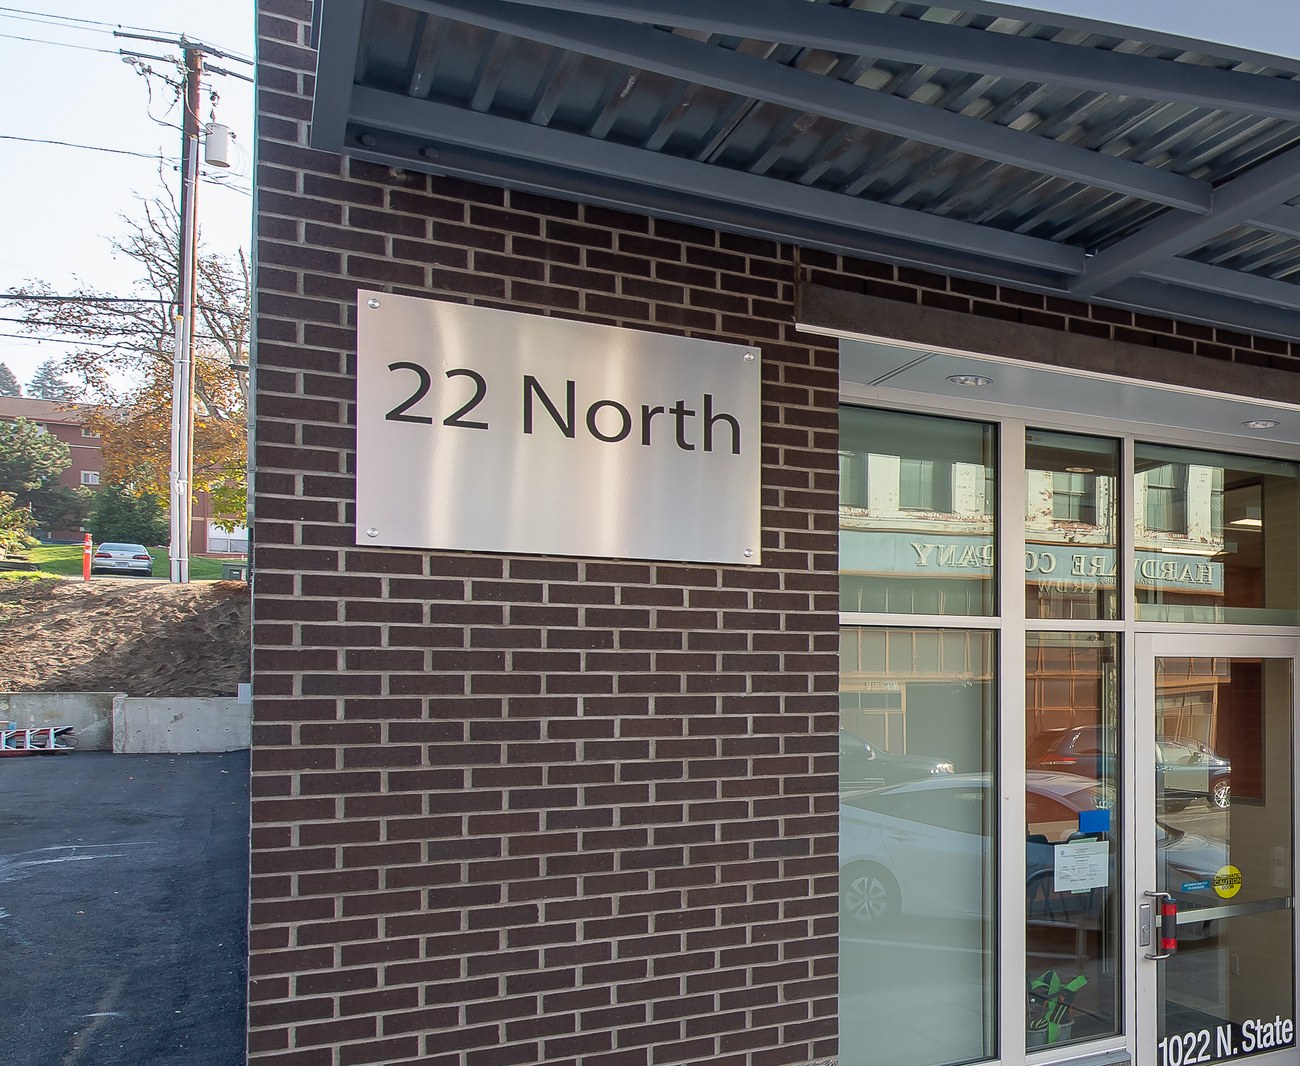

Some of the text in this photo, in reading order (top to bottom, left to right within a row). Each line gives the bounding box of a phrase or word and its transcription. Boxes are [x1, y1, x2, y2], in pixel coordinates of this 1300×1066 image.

[385, 361, 741, 455] 22 North
[1213, 875, 1242, 887] CAUTION
[1158, 1015, 1293, 1066] 1022 N. State
